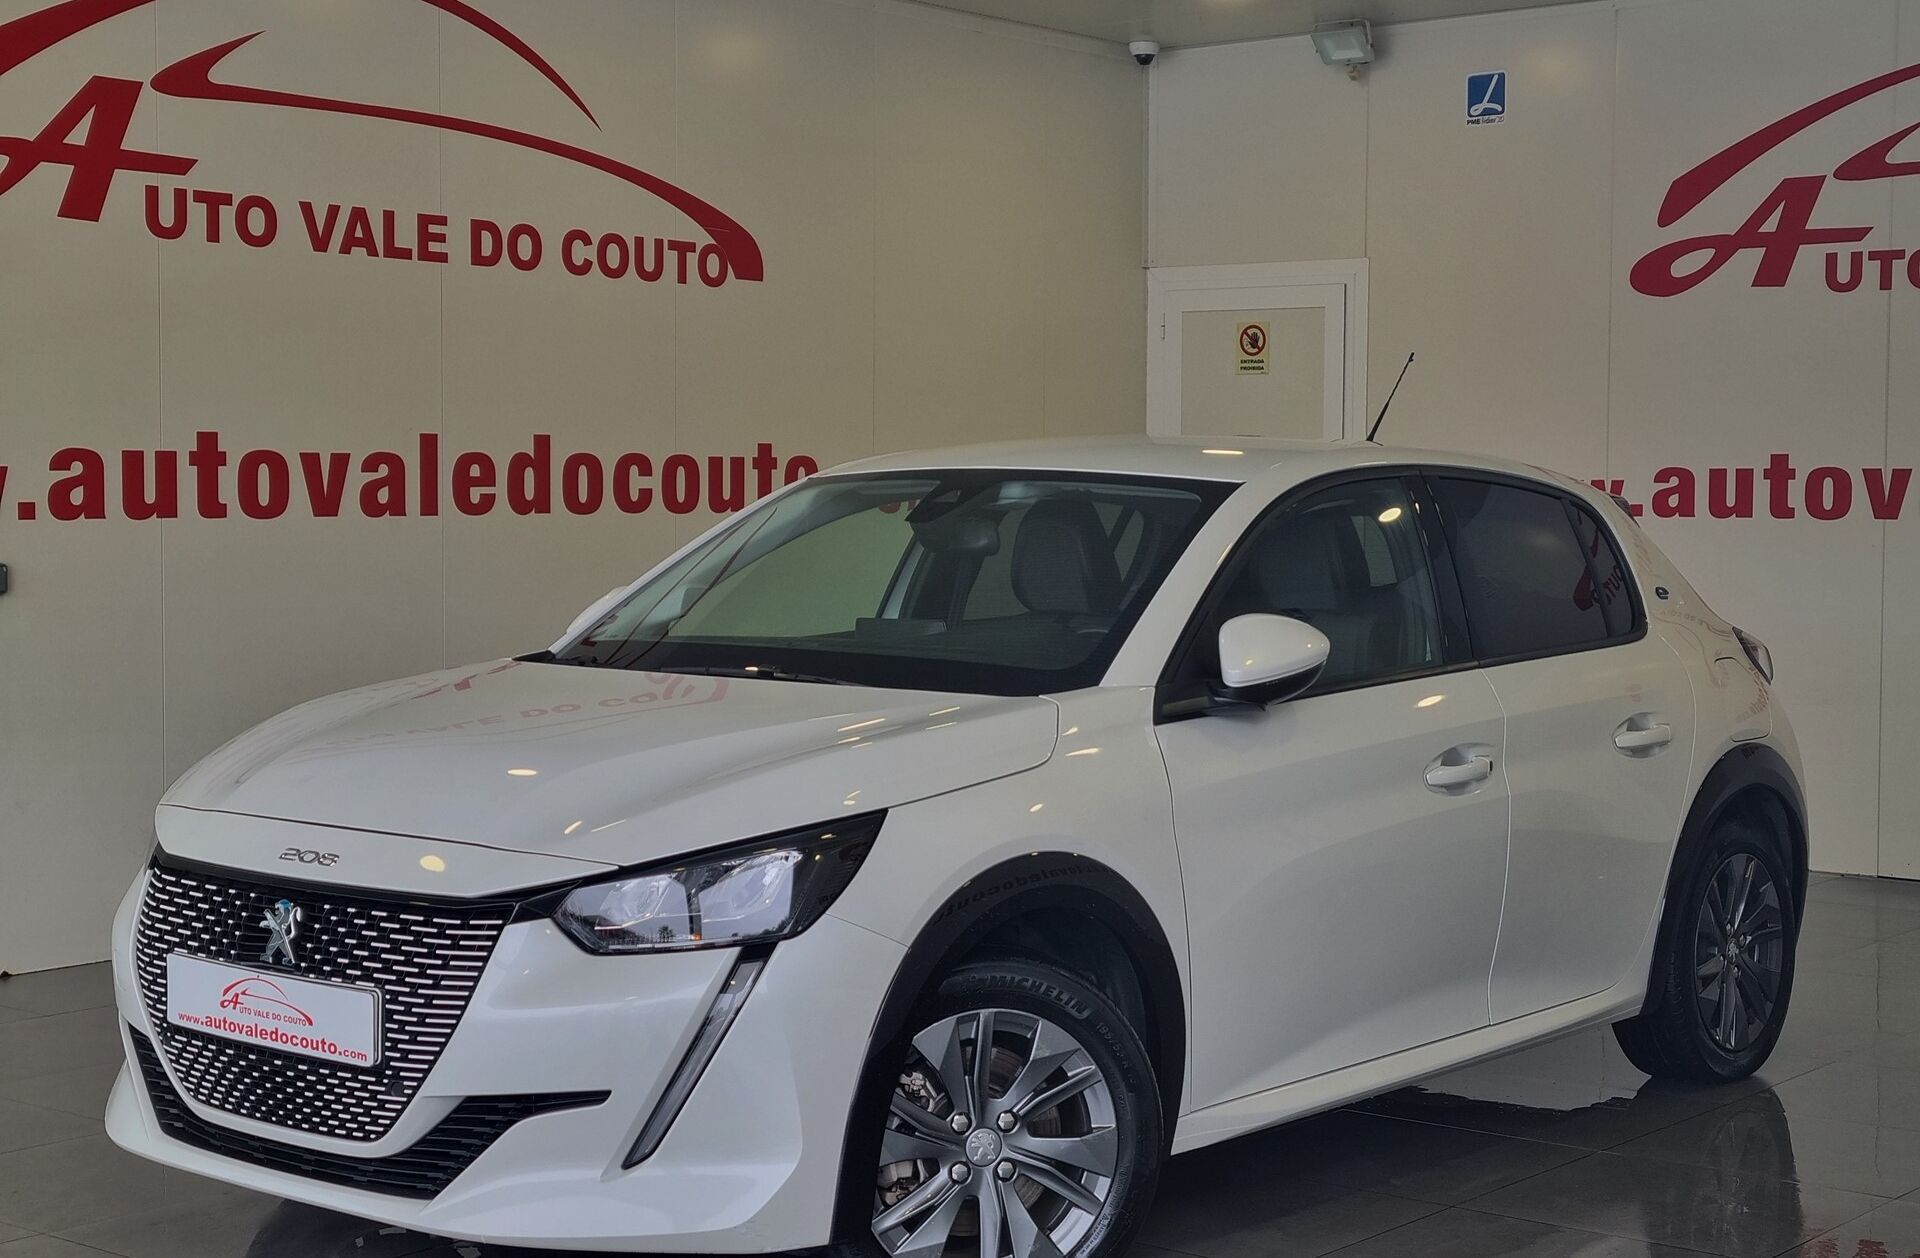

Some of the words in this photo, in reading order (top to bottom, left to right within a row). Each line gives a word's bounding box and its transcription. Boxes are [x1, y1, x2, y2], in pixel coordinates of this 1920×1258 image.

[300, 201, 449, 264] VALE
[470, 219, 544, 272] DO
[562, 228, 730, 288] COUTO
[279, 847, 340, 866] 208
[253, 1008, 271, 1020] VALE
[272, 1012, 282, 1022] DO
[283, 1014, 307, 1027] COUTO
[987, 974, 1090, 1018] MICHELIN
[178, 1012, 368, 1062] www.autovaledocouto.com
